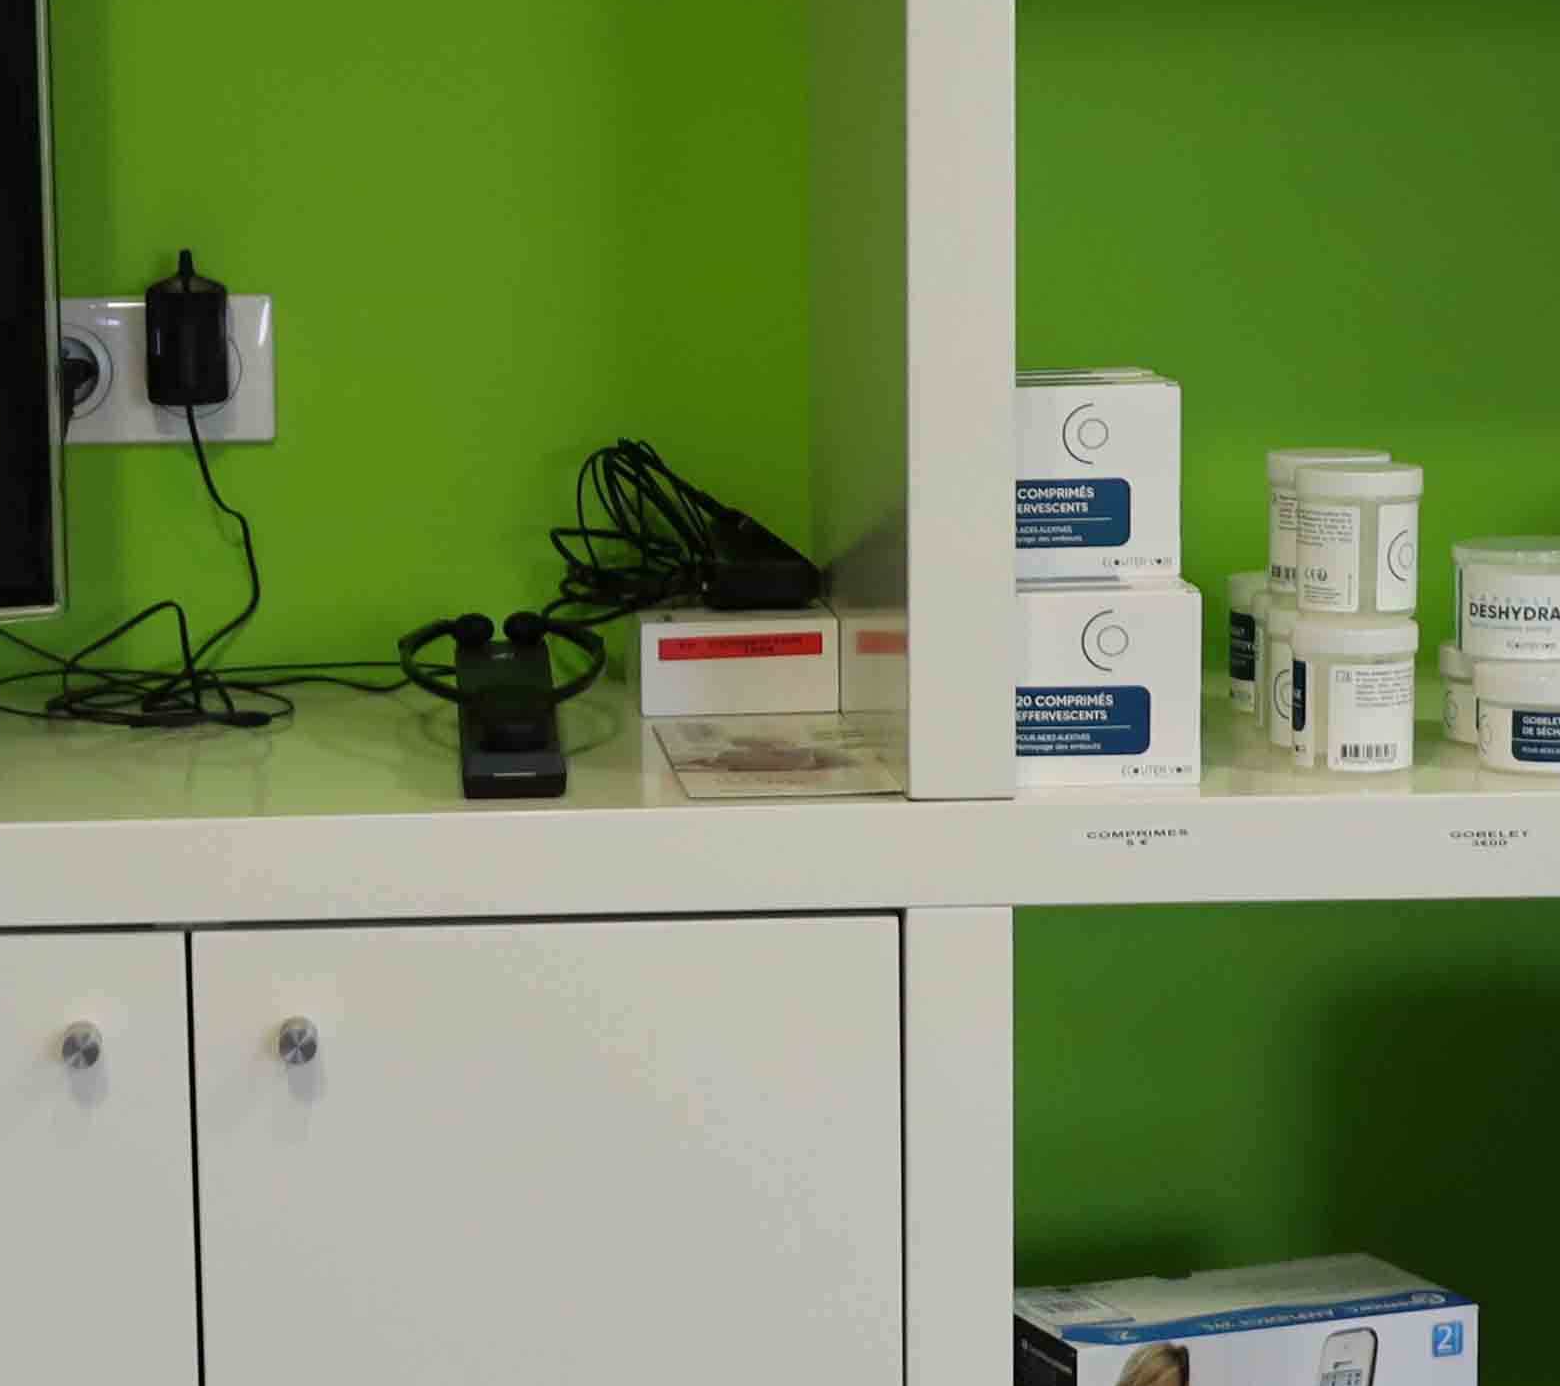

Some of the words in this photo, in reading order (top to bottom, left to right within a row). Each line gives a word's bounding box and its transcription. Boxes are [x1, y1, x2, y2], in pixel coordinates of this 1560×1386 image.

[1017, 484, 1095, 501] COMPRIMÉS
[1035, 692, 1114, 709] COMPRIMÉS
[1522, 726, 1535, 736] DE
